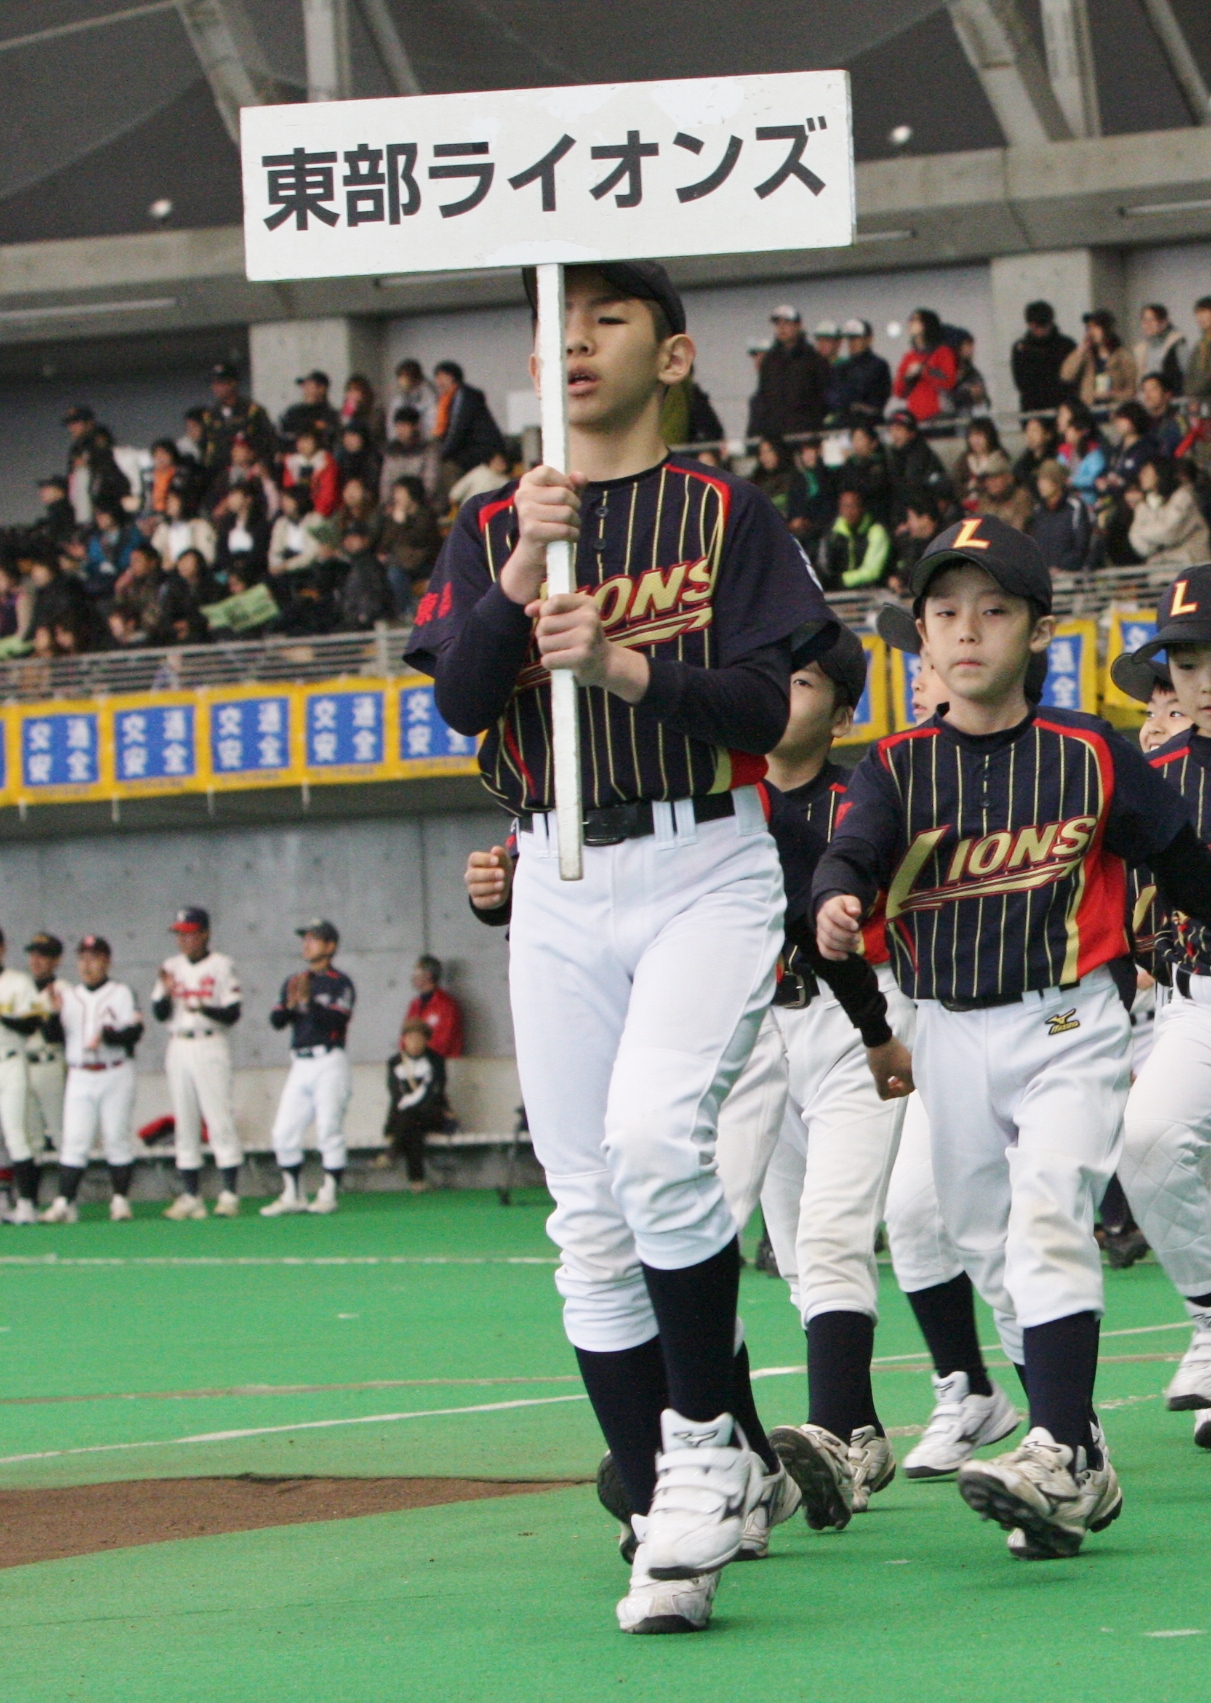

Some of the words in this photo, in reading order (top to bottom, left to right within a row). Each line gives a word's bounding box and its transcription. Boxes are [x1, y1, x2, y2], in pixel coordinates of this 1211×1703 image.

[261, 115, 827, 232] 東部ライオンズ
[951, 517, 991, 549] L
[1169, 580, 1199, 617] L
[885, 814, 1098, 922] LIONS
